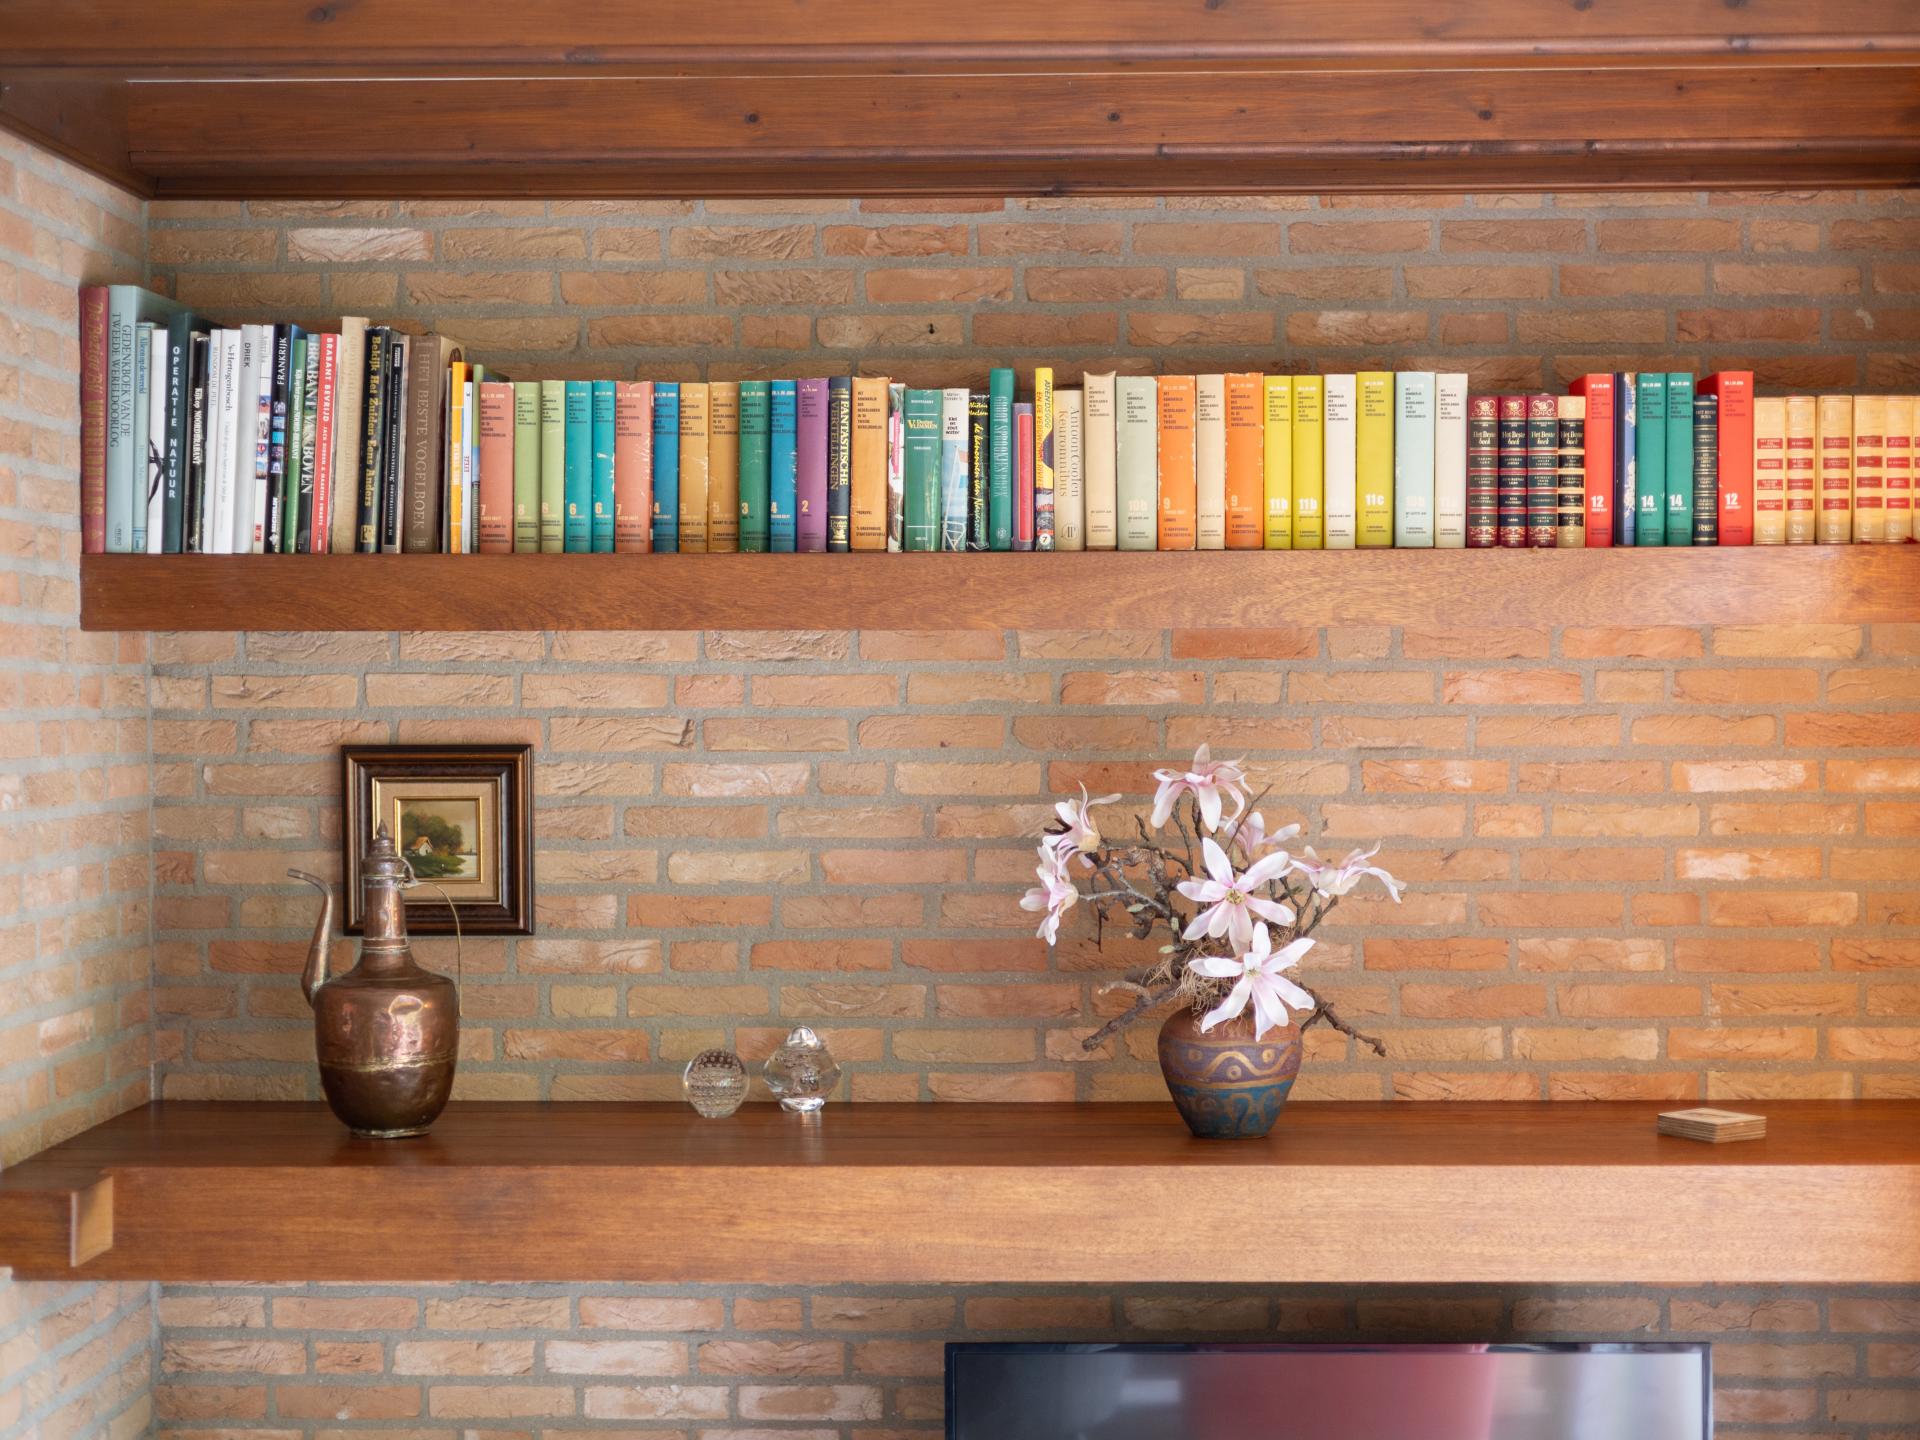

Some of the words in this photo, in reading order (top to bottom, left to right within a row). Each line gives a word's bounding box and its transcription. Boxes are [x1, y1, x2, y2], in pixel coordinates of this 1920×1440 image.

[111, 312, 121, 356] TWEEDE
[121, 325, 132, 397] GEDENKBOEK
[243, 342, 251, 368] DRIEK
[276, 337, 288, 385] FRANKRIJK
[325, 337, 333, 381] BRABANT
[369, 336, 382, 371] Bekijk
[225, 344, 236, 412] 's-Hertogenbosch
[305, 342, 320, 408] BRABANT
[418, 353, 431, 384] HET
[171, 346, 181, 427] OPERATIE
[369, 375, 380, 394] Het
[1036, 391, 1043, 400] EN
[110, 359, 121, 448] WERELDOORLOG
[121, 399, 131, 421] VAN
[322, 384, 331, 422] BEVRIJD
[368, 397, 380, 436] Zuiden
[416, 390, 429, 436] BESTE
[994, 396, 1009, 423] GROOT
[1036, 404, 1043, 413] DE
[1043, 379, 1052, 429] ARENDSOOG
[120, 423, 131, 437] DE
[302, 415, 317, 444] VAN
[973, 423, 984, 433] de
[1070, 406, 1080, 454] Antoon
[367, 439, 377, 465] Eens
[830, 400, 840, 490] VERTELLINGEN
[839, 400, 850, 486] FANTASTISCHE
[973, 435, 983, 478] kanonnen
[168, 438, 178, 498] NATUUR
[301, 446, 315, 494] BOVEN
[1070, 455, 1081, 497] Coolen
[365, 468, 376, 507] Anders
[413, 439, 428, 529] VOGELBOEK
[1724, 492, 1738, 505] 12
[480, 504, 487, 515] 7
[616, 504, 622, 516] 7
[654, 503, 660, 514] 4
[742, 503, 749, 514] 3
[771, 502, 778, 513] 4
[802, 500, 809, 512] 2
[1163, 497, 1171, 510] 9
[1231, 495, 1239, 507] 9
[1270, 497, 1288, 511] 11b
[1299, 497, 1317, 511] 11b
[1365, 494, 1384, 506] 11c
[1591, 495, 1604, 508] 12
[1641, 495, 1655, 508] 14
[1669, 494, 1683, 506] 14
[971, 497, 984, 538] Navarone
